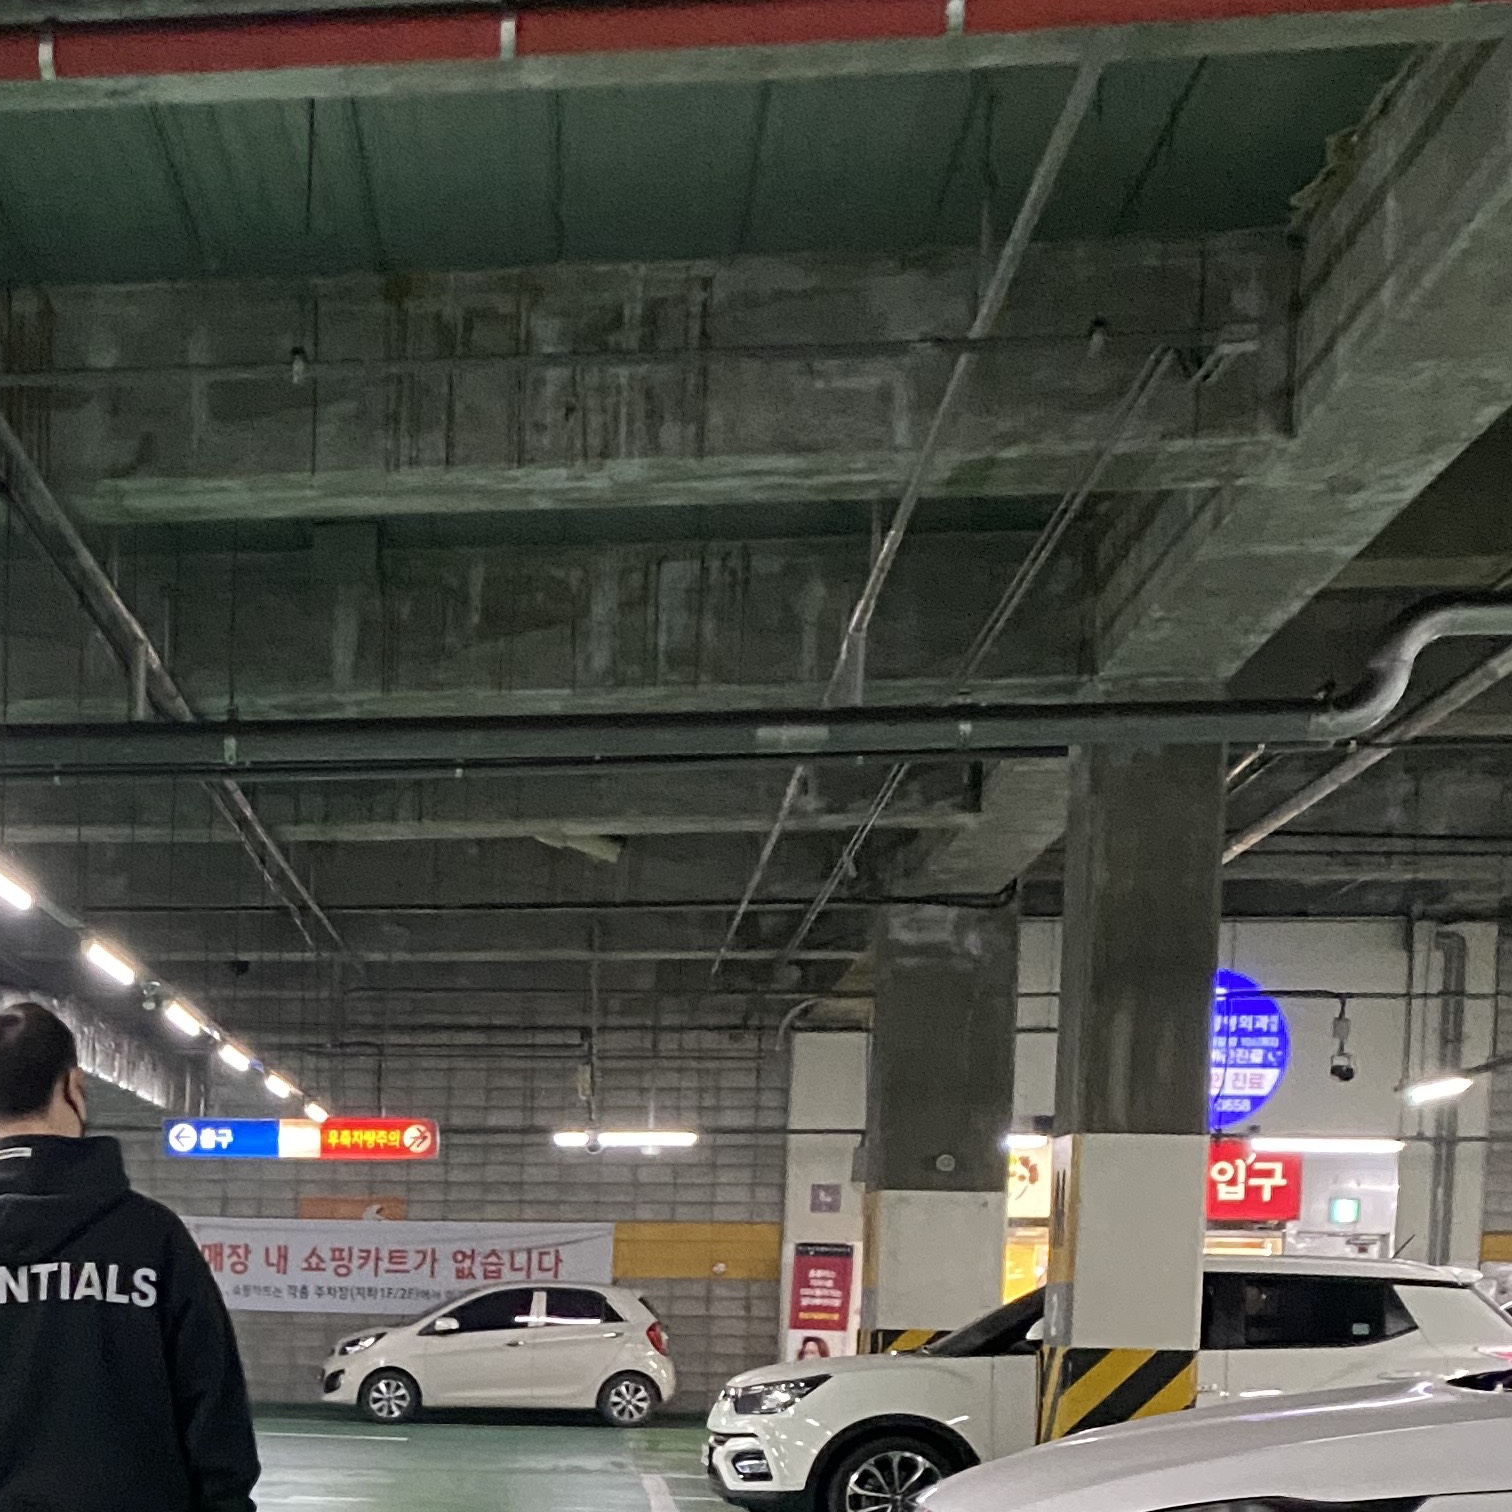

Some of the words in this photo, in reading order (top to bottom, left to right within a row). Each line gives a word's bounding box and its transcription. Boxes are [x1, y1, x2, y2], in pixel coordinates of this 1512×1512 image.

[1231, 1071, 1265, 1091] 진료
[1210, 1158, 1288, 1202] 입구
[264, 1243, 288, 1275] 내
[300, 1245, 439, 1279] 쇼핑카트가
[451, 1248, 564, 1280] 없습니다
